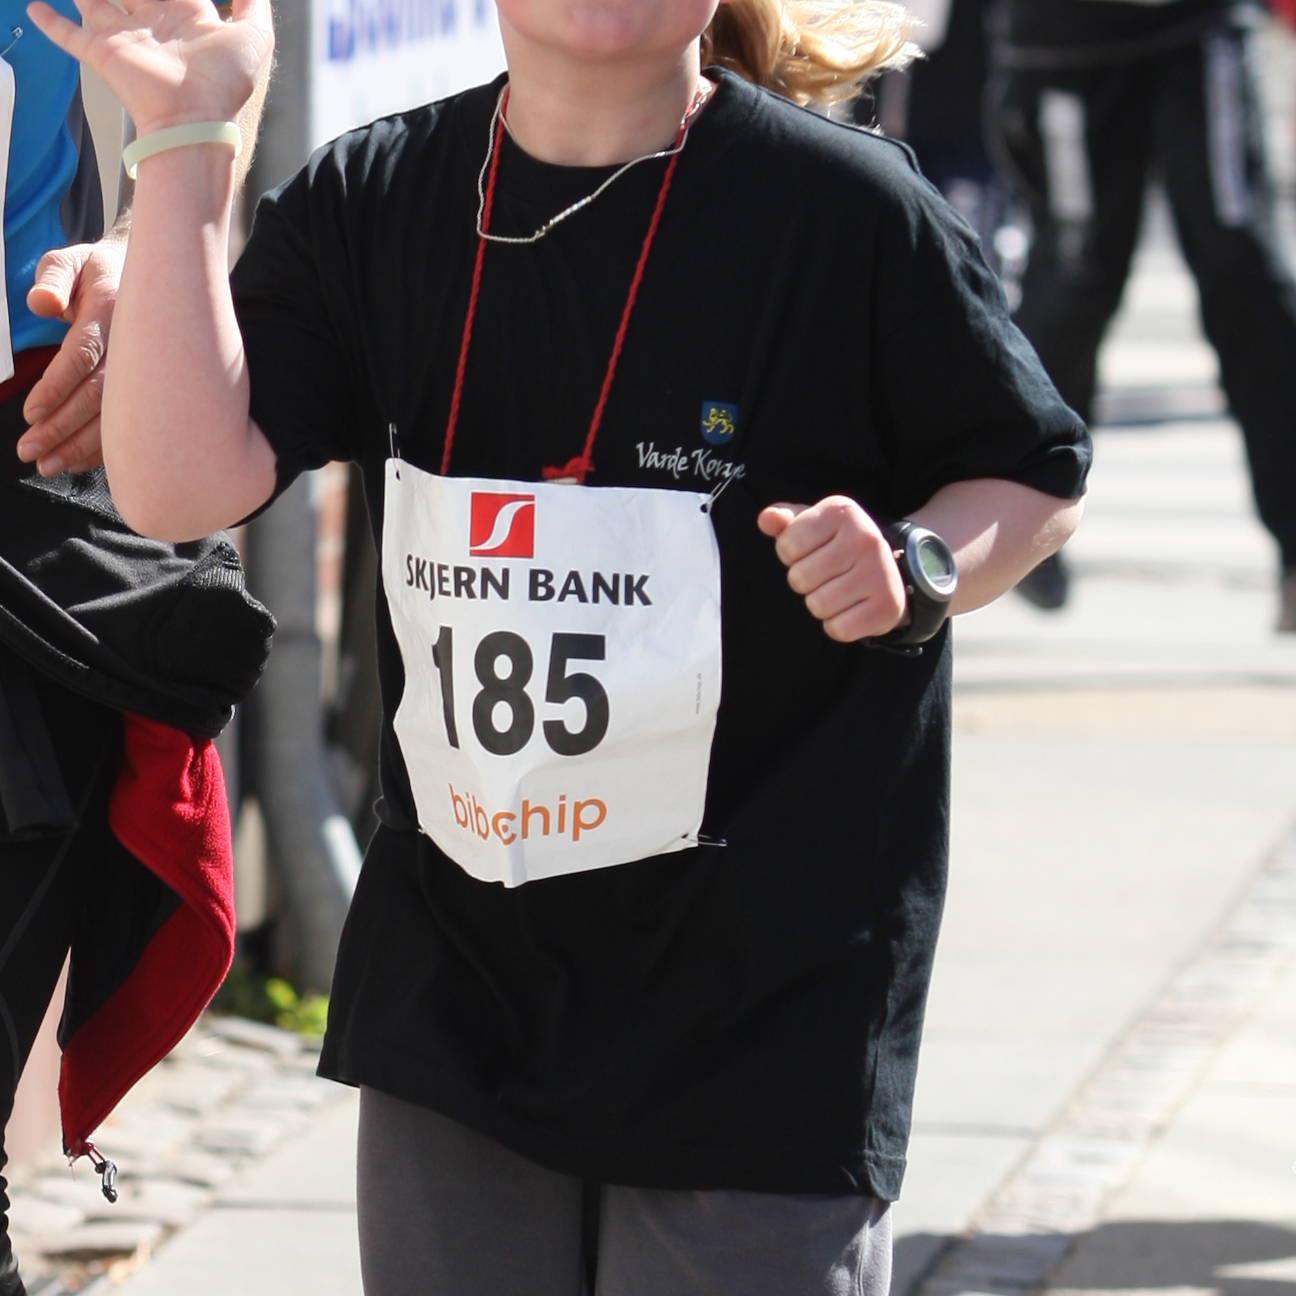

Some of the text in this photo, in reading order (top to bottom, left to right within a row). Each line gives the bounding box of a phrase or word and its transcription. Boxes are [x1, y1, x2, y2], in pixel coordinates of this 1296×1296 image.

[635, 441, 689, 480] Varde
[405, 553, 652, 606] SKJERN BANK
[432, 625, 610, 757] 185
[449, 783, 607, 846] bibchip
